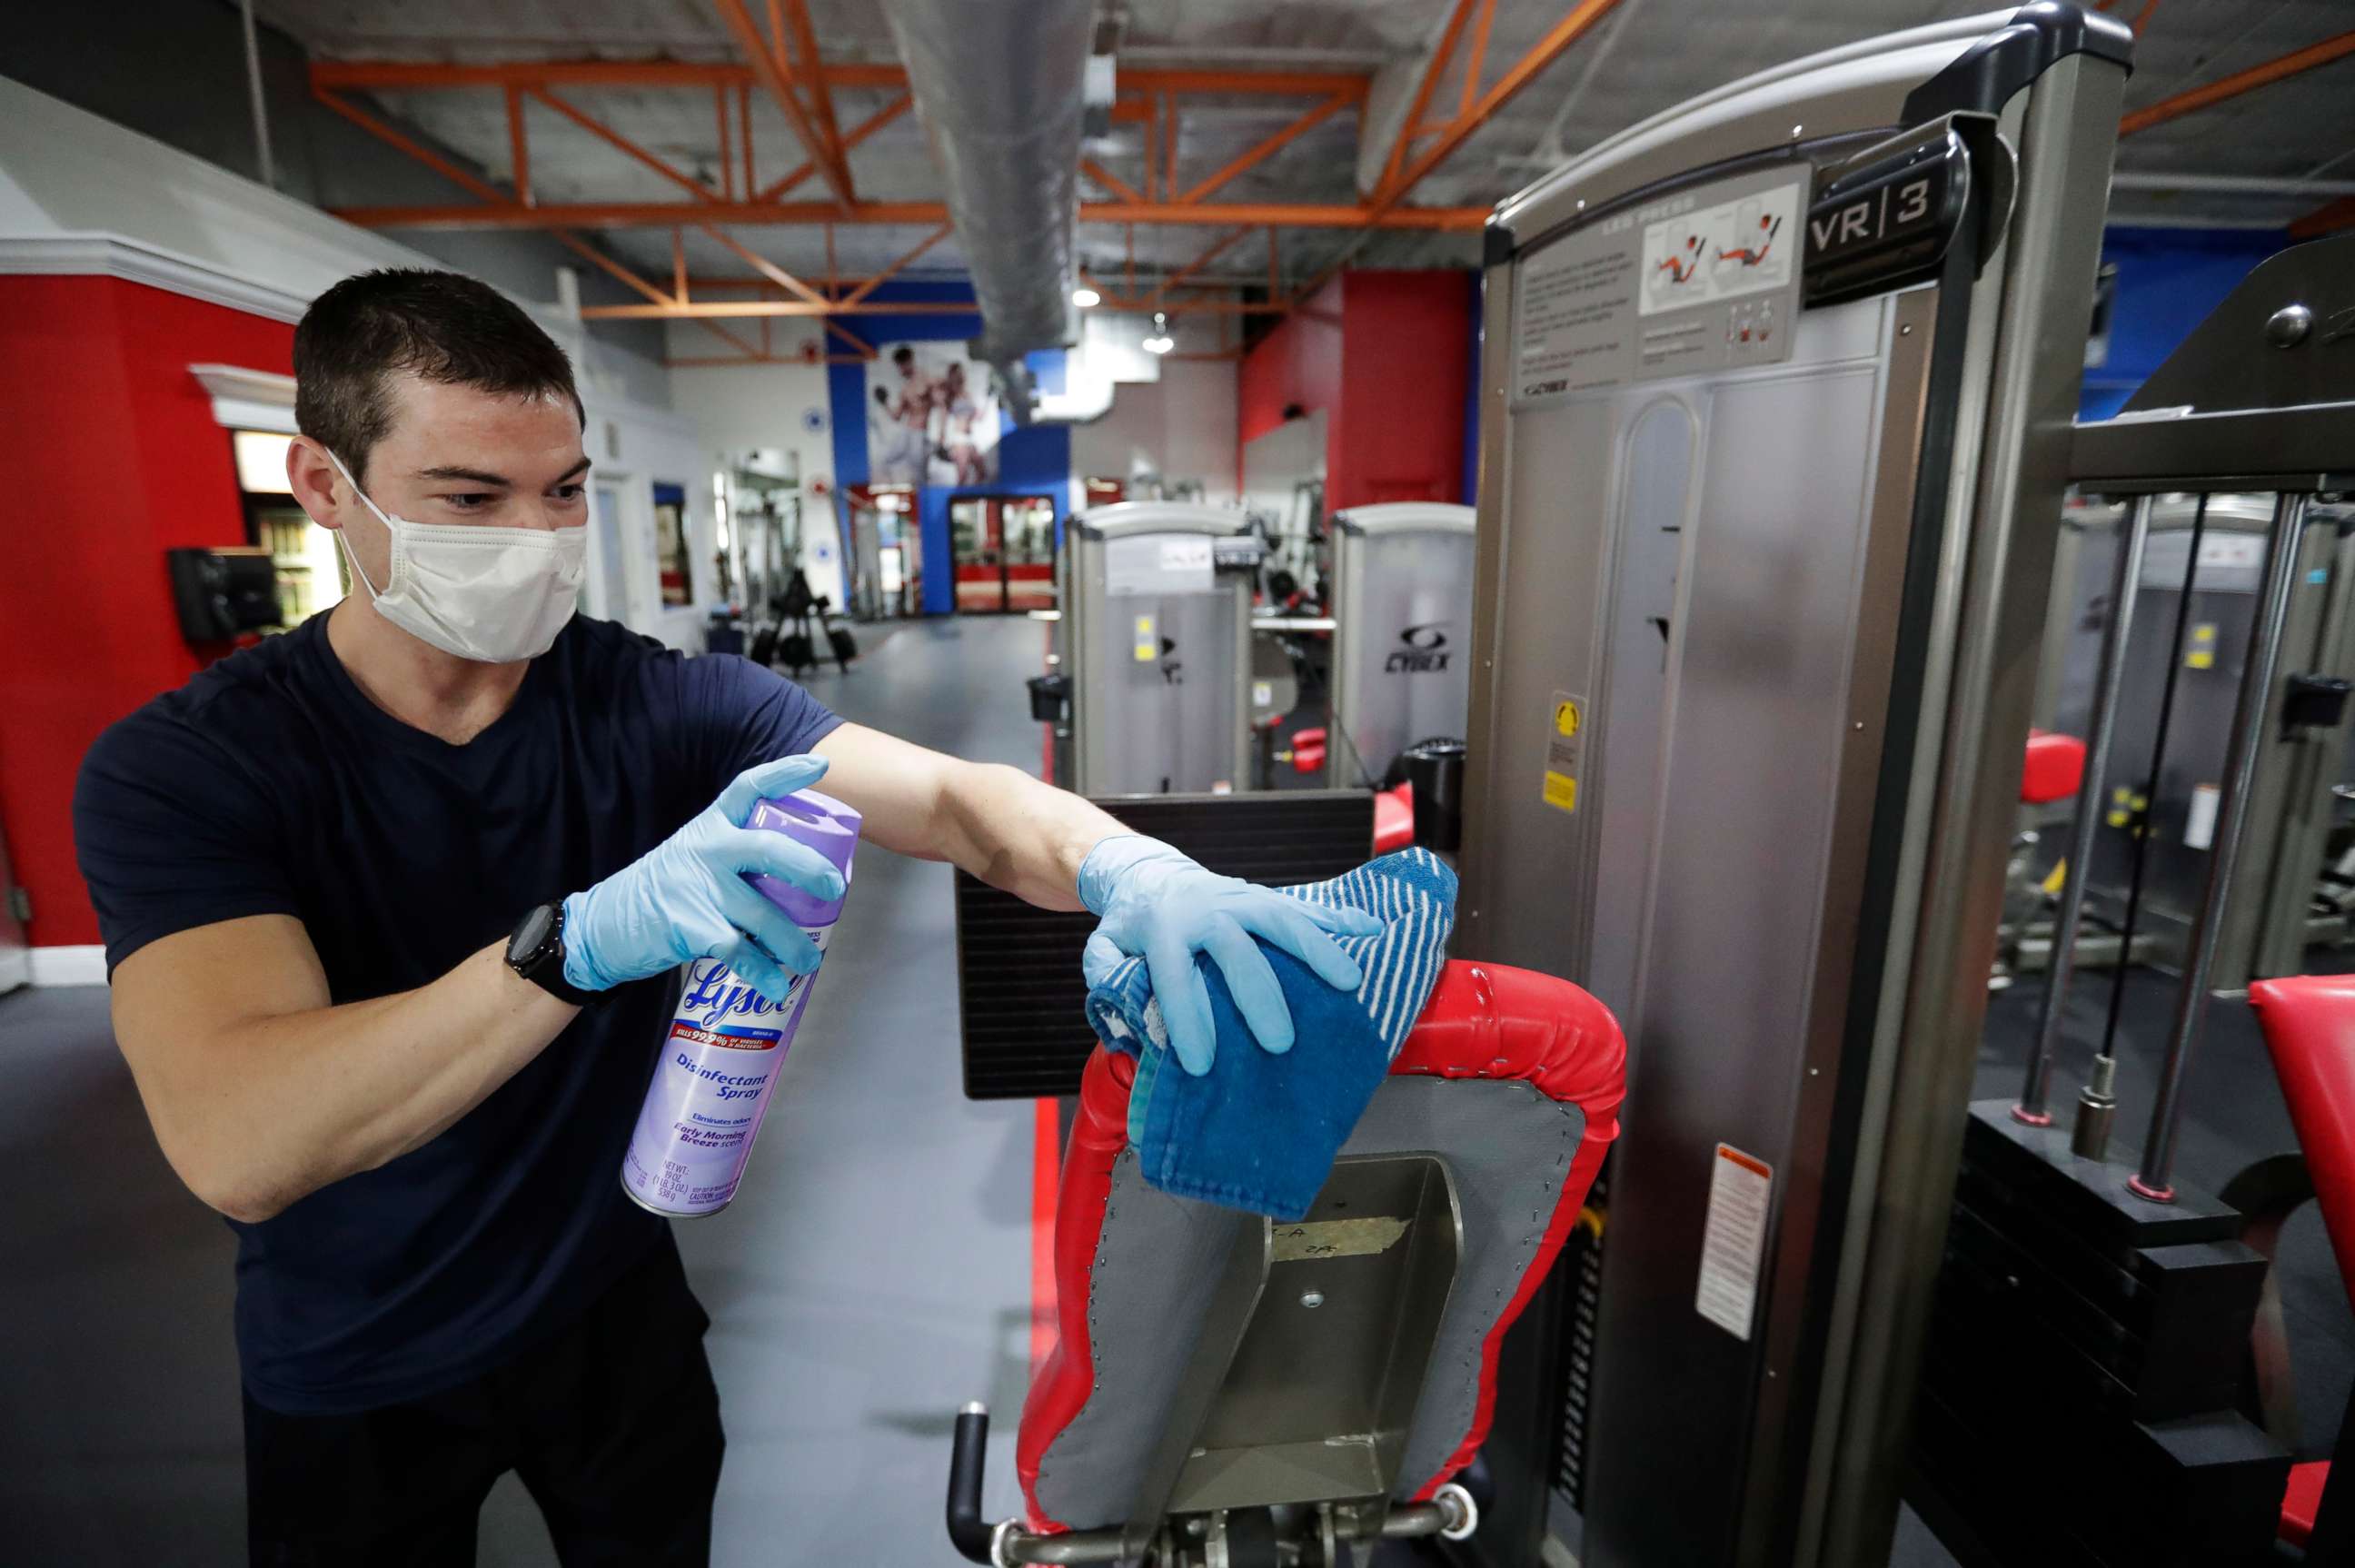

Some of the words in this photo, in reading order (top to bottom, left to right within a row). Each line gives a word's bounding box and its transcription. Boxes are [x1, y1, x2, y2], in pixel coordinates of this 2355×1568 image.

[1384, 652, 1453, 674] CYBEX
[676, 1028, 692, 1038] KILLS
[691, 1029, 728, 1047] 99.9%
[676, 1052, 769, 1087] Disinfectant
[716, 1086, 763, 1100] Spray
[692, 1113, 731, 1126] Eliminates
[674, 1122, 702, 1138] Early
[703, 1130, 747, 1142] Morning
[680, 1133, 719, 1147] Breeze
[720, 1138, 744, 1147] scent
